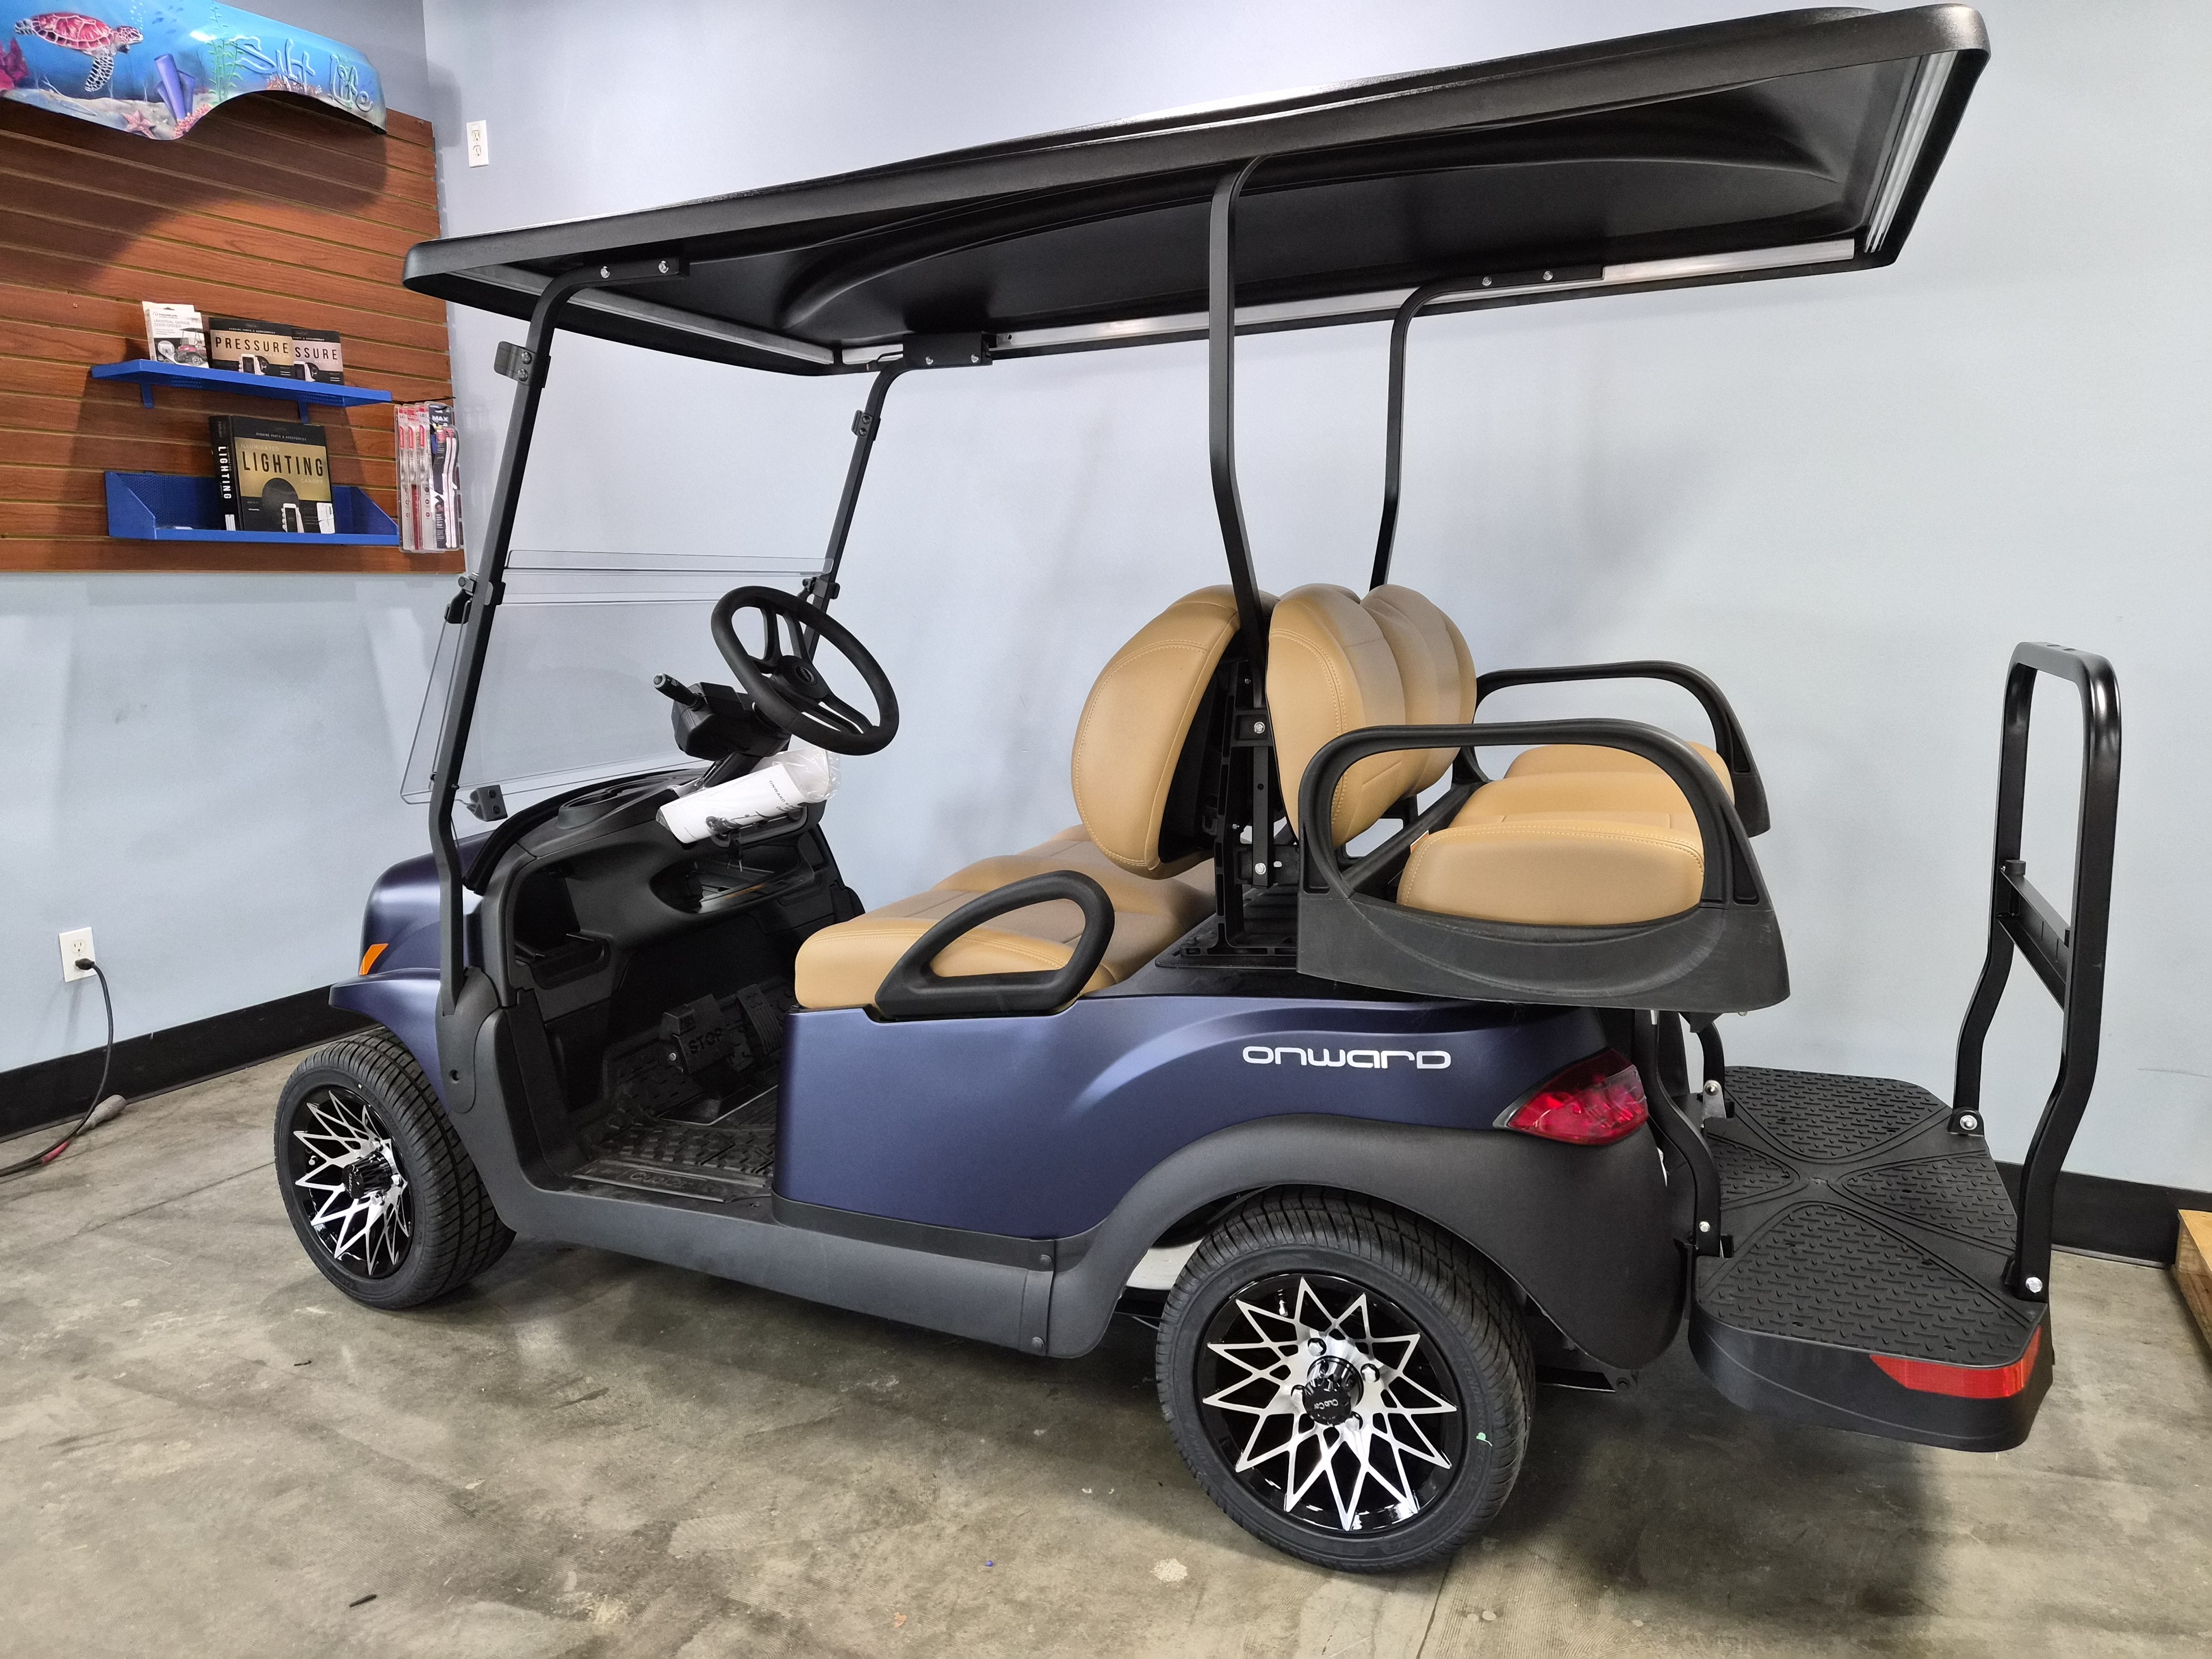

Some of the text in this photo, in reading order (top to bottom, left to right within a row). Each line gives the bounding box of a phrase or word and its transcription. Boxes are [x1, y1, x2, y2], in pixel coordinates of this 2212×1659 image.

[215, 337, 289, 353] PRESSURE
[295, 347, 338, 360] SSURE
[241, 444, 279, 452] ILLUMINATED
[218, 446, 232, 499] LIGHTING
[242, 451, 324, 477] LIGHTING
[769, 780, 785, 802] ONWARD
[689, 1027, 723, 1053] STOP
